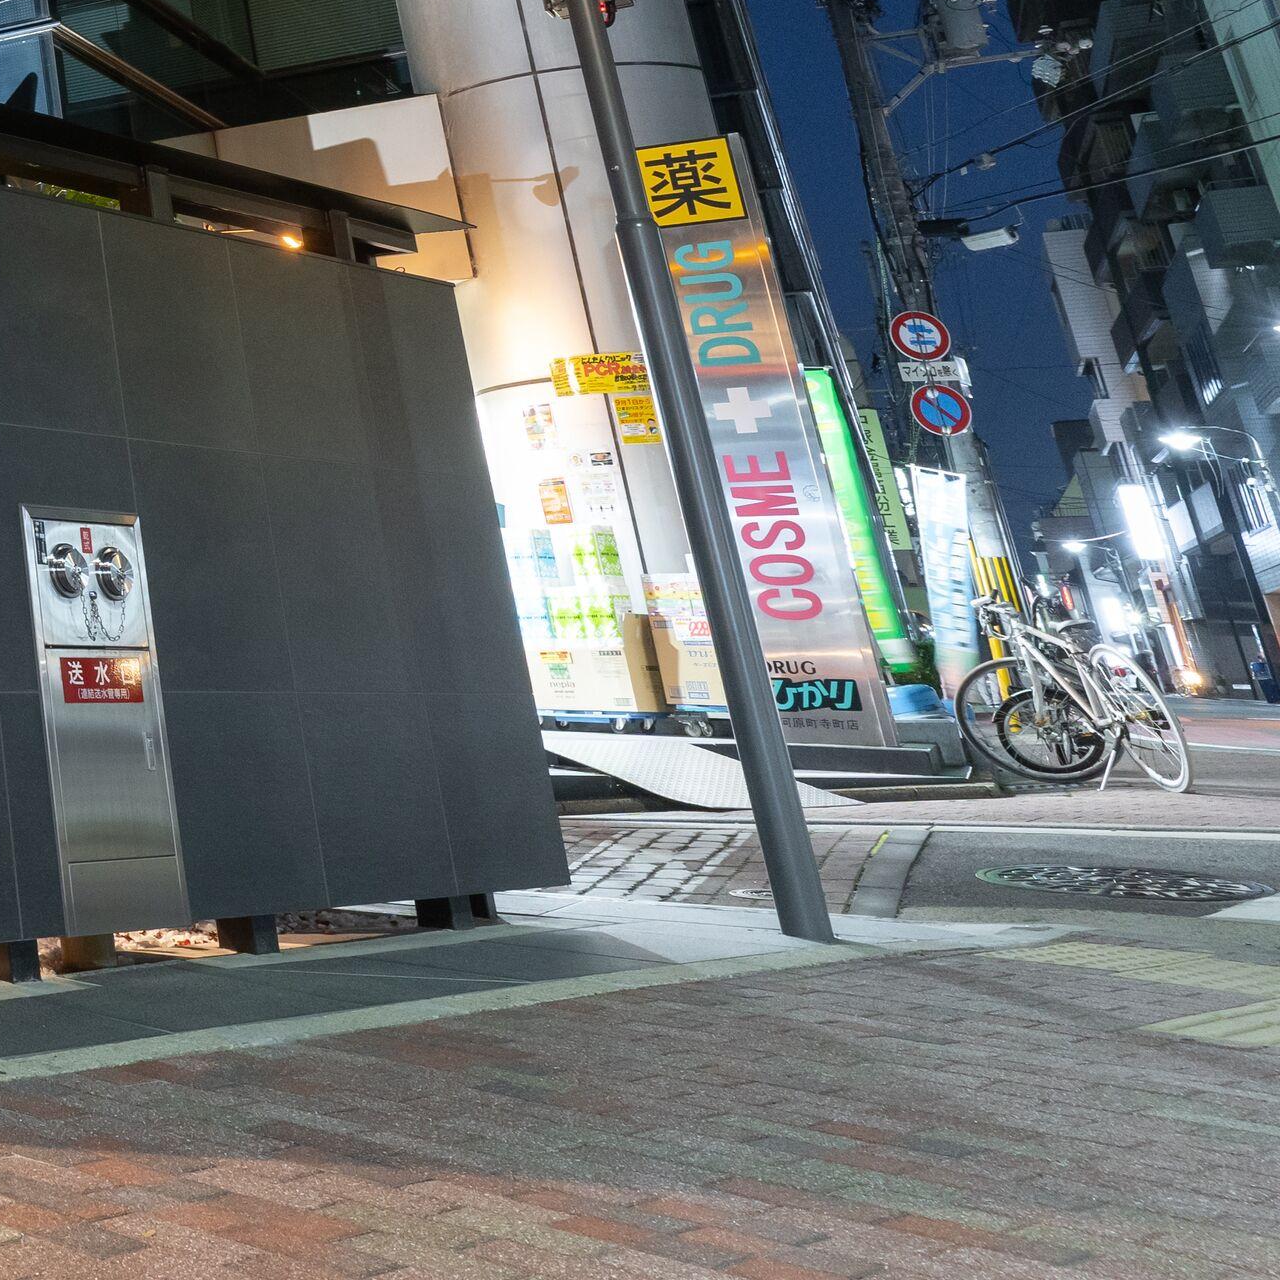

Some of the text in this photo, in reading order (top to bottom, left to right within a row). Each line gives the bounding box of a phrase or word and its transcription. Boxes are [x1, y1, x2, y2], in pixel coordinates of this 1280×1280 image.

[644, 150, 732, 218] 薬
[674, 239, 763, 367] DRUG
[723, 451, 823, 620] COSME
[67, 661, 137, 685] 送水口
